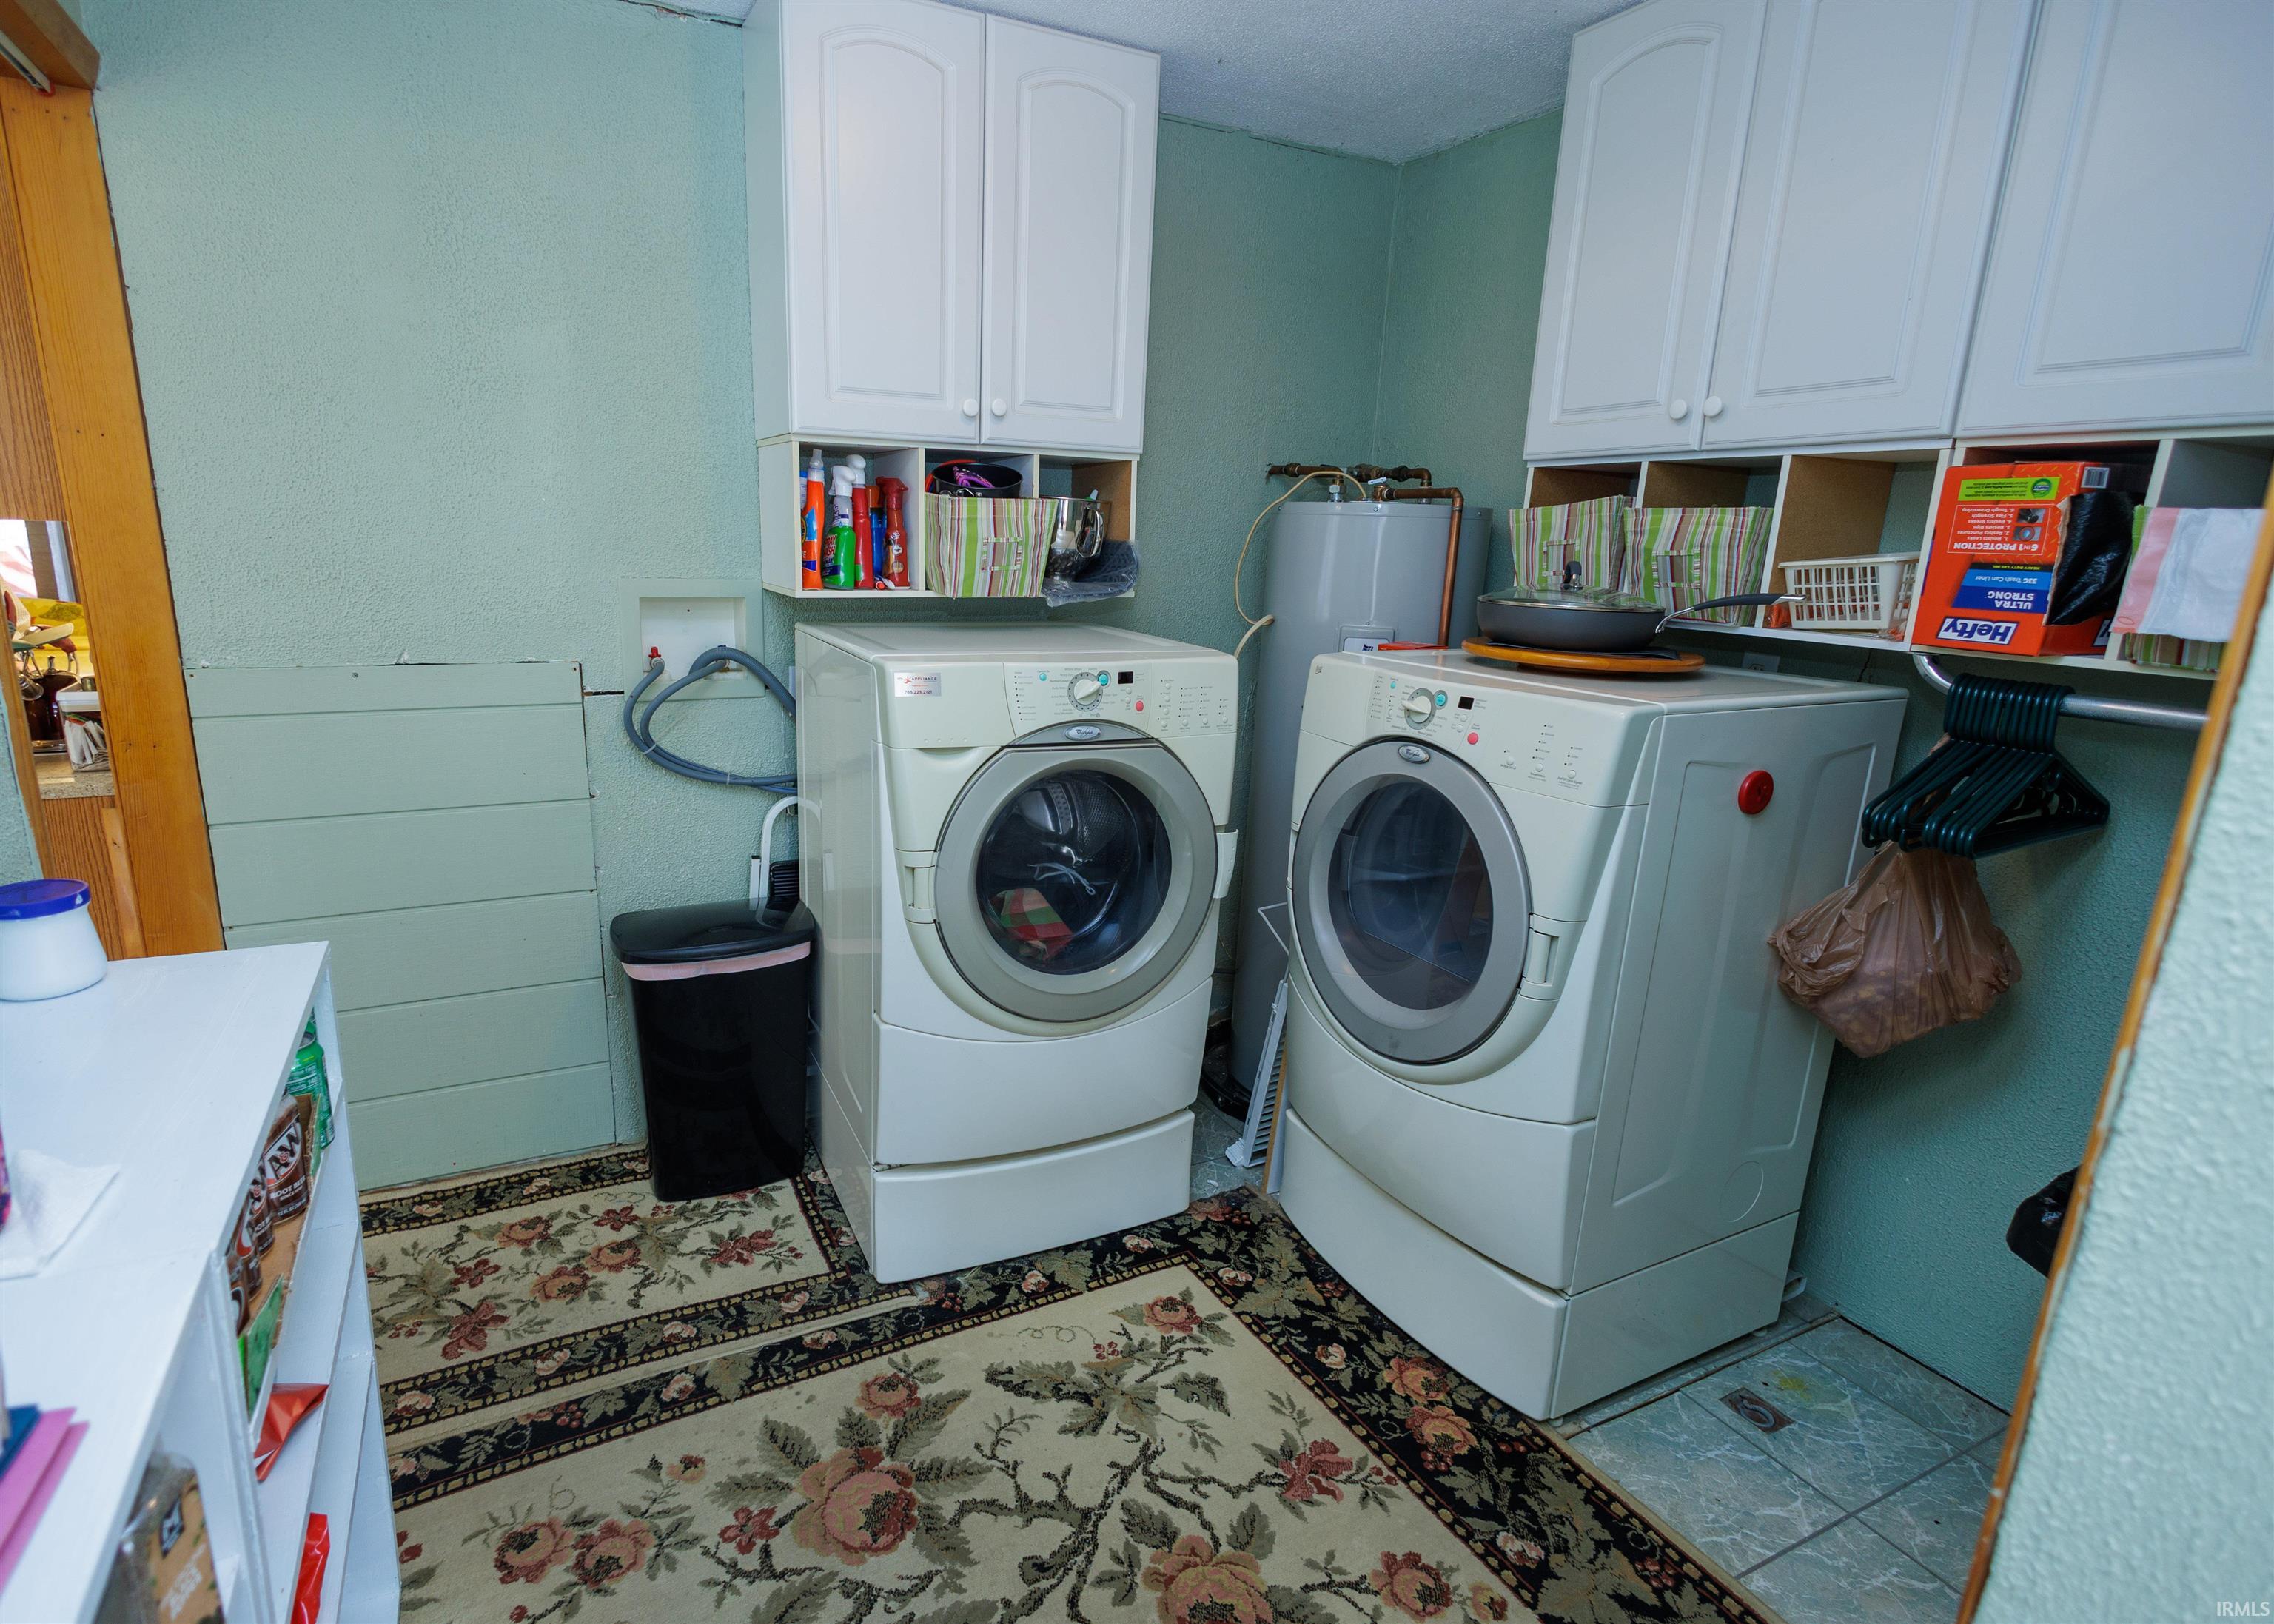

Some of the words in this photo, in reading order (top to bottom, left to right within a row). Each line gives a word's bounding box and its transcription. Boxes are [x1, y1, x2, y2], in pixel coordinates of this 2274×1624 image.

[1953, 543, 2017, 551] PROTECTION
[1987, 591, 2035, 601] STRONG
[1994, 600, 2032, 609] ULTRA
[1943, 618, 2012, 641] Hefty
[270, 1185, 293, 1199] ROOT
